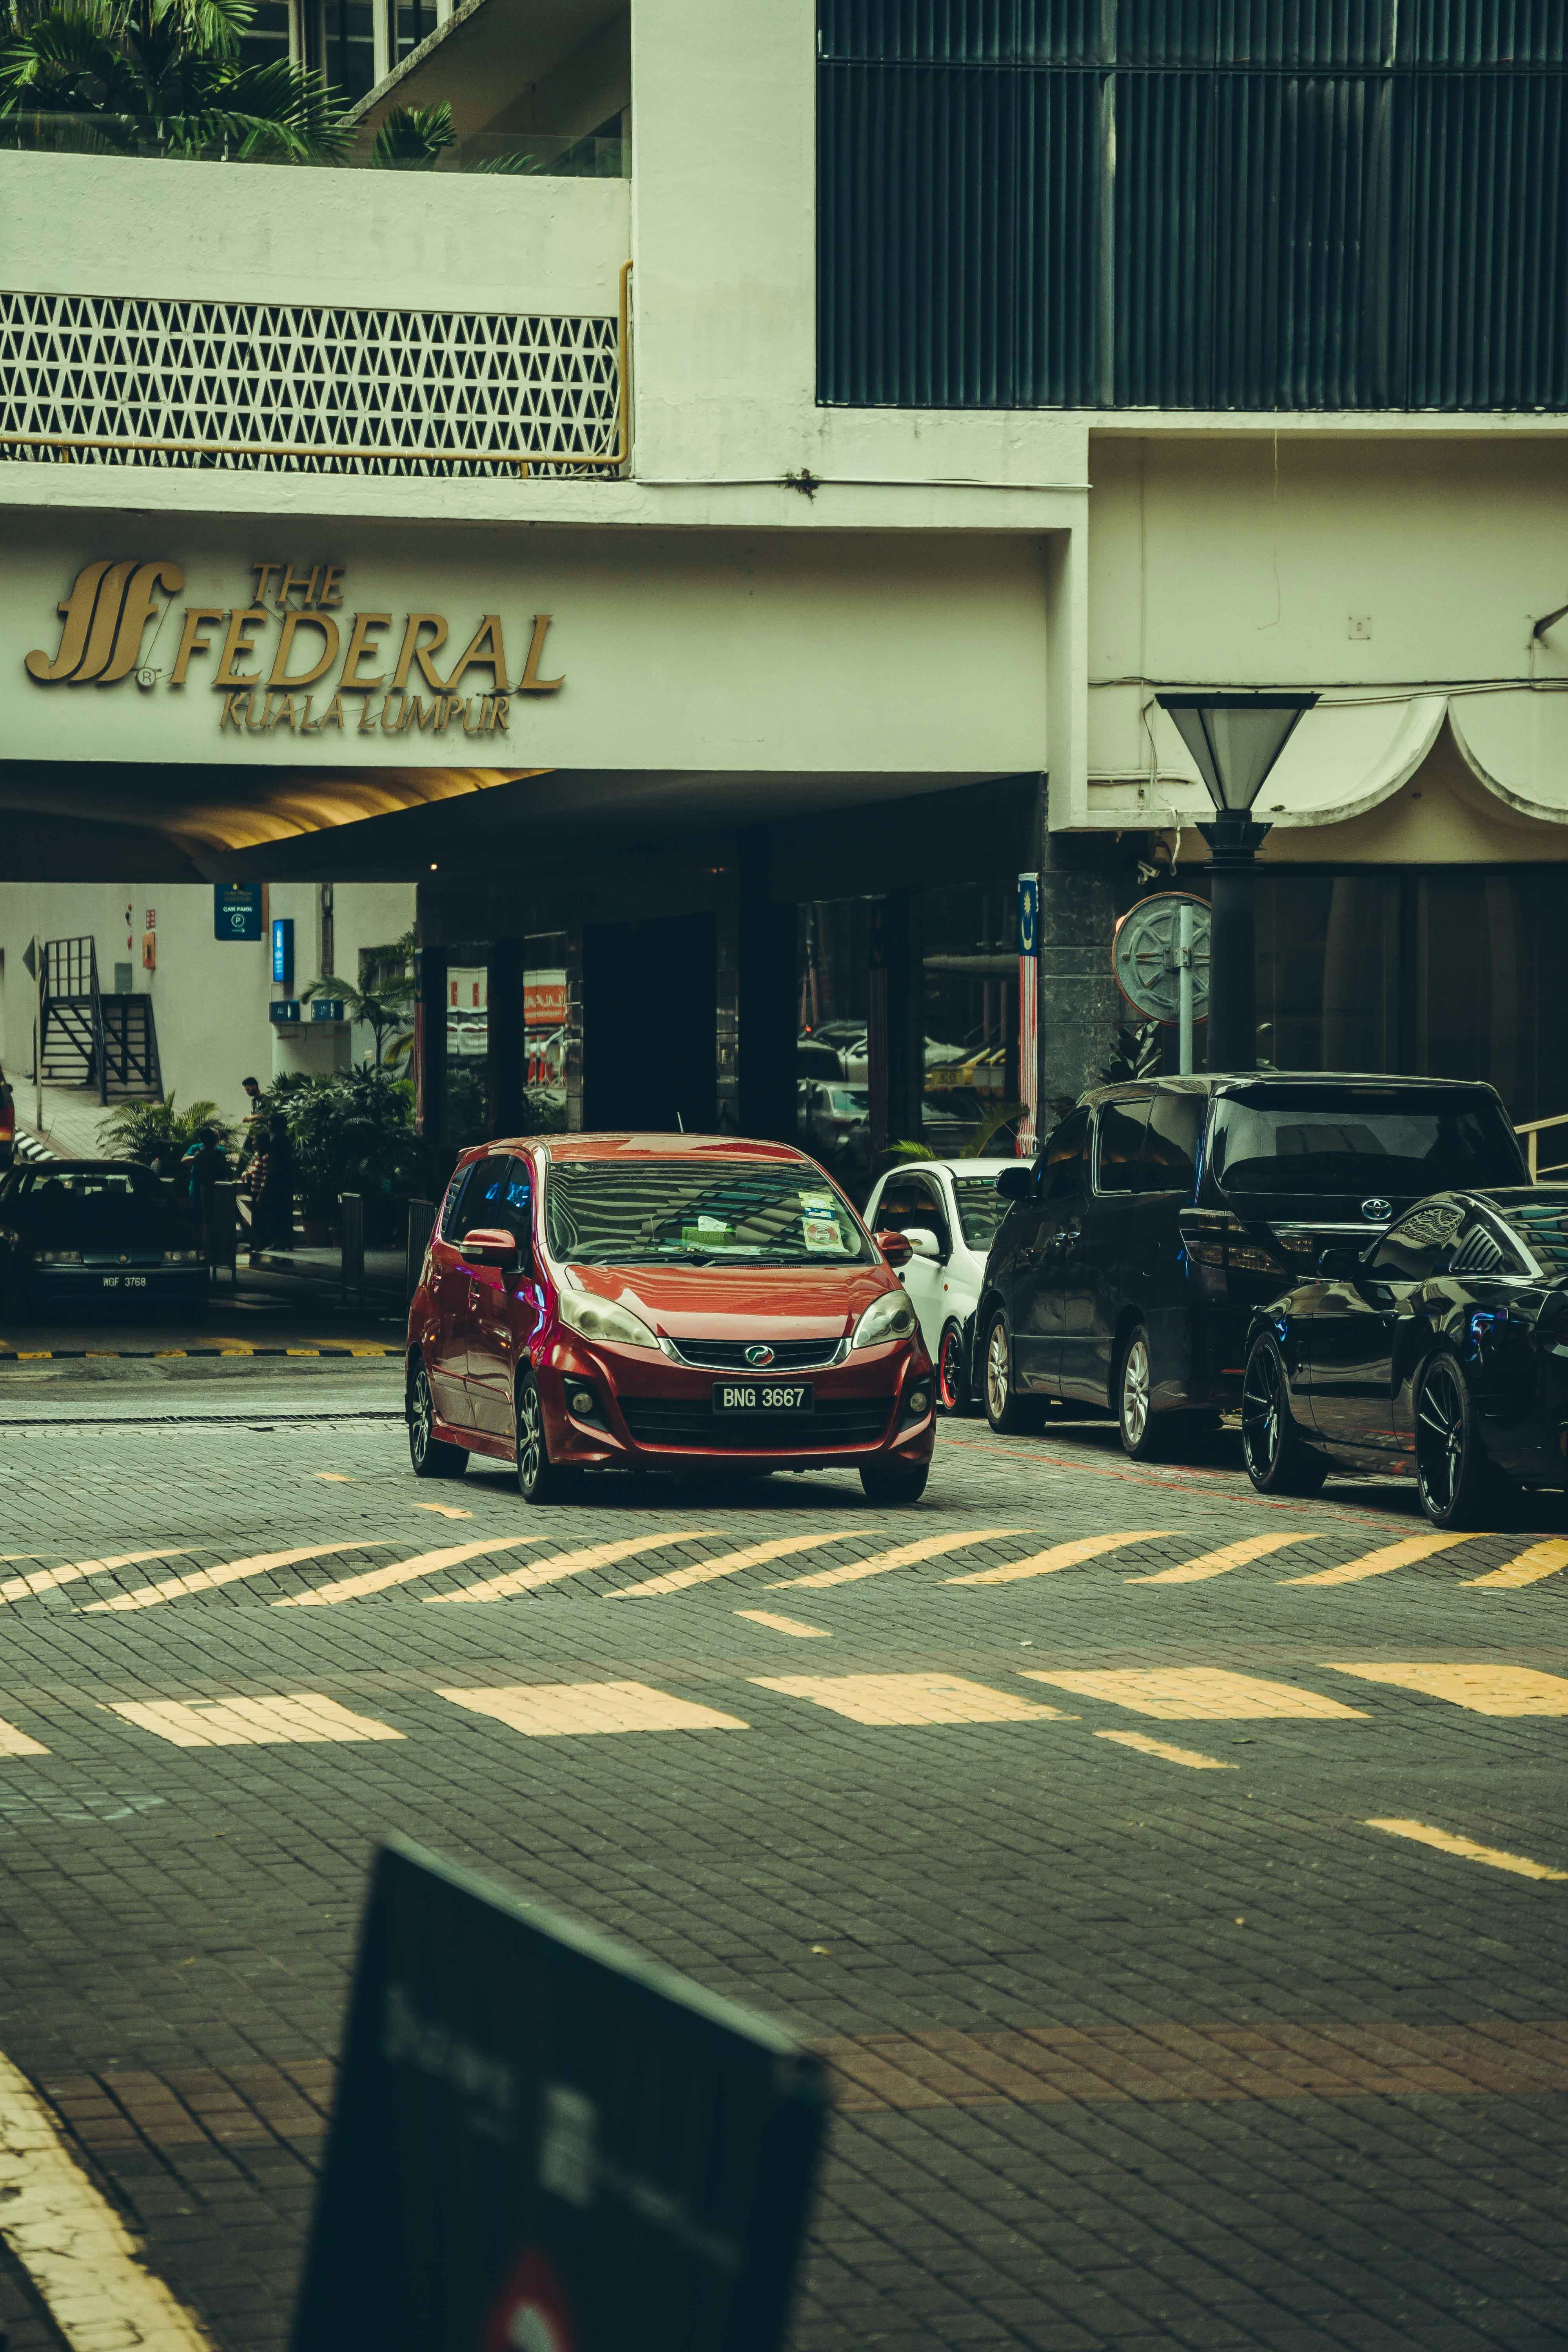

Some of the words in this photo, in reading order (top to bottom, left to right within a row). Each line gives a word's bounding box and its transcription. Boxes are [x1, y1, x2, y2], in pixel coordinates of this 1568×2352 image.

[251, 563, 346, 606] THE
[167, 608, 566, 690] FEDERAL
[219, 692, 345, 728] KUALA
[358, 694, 511, 730] LUMPUR
[103, 1278, 119, 1286] WGF
[724, 1389, 755, 1406] BNG
[762, 1389, 804, 1406] 3667
